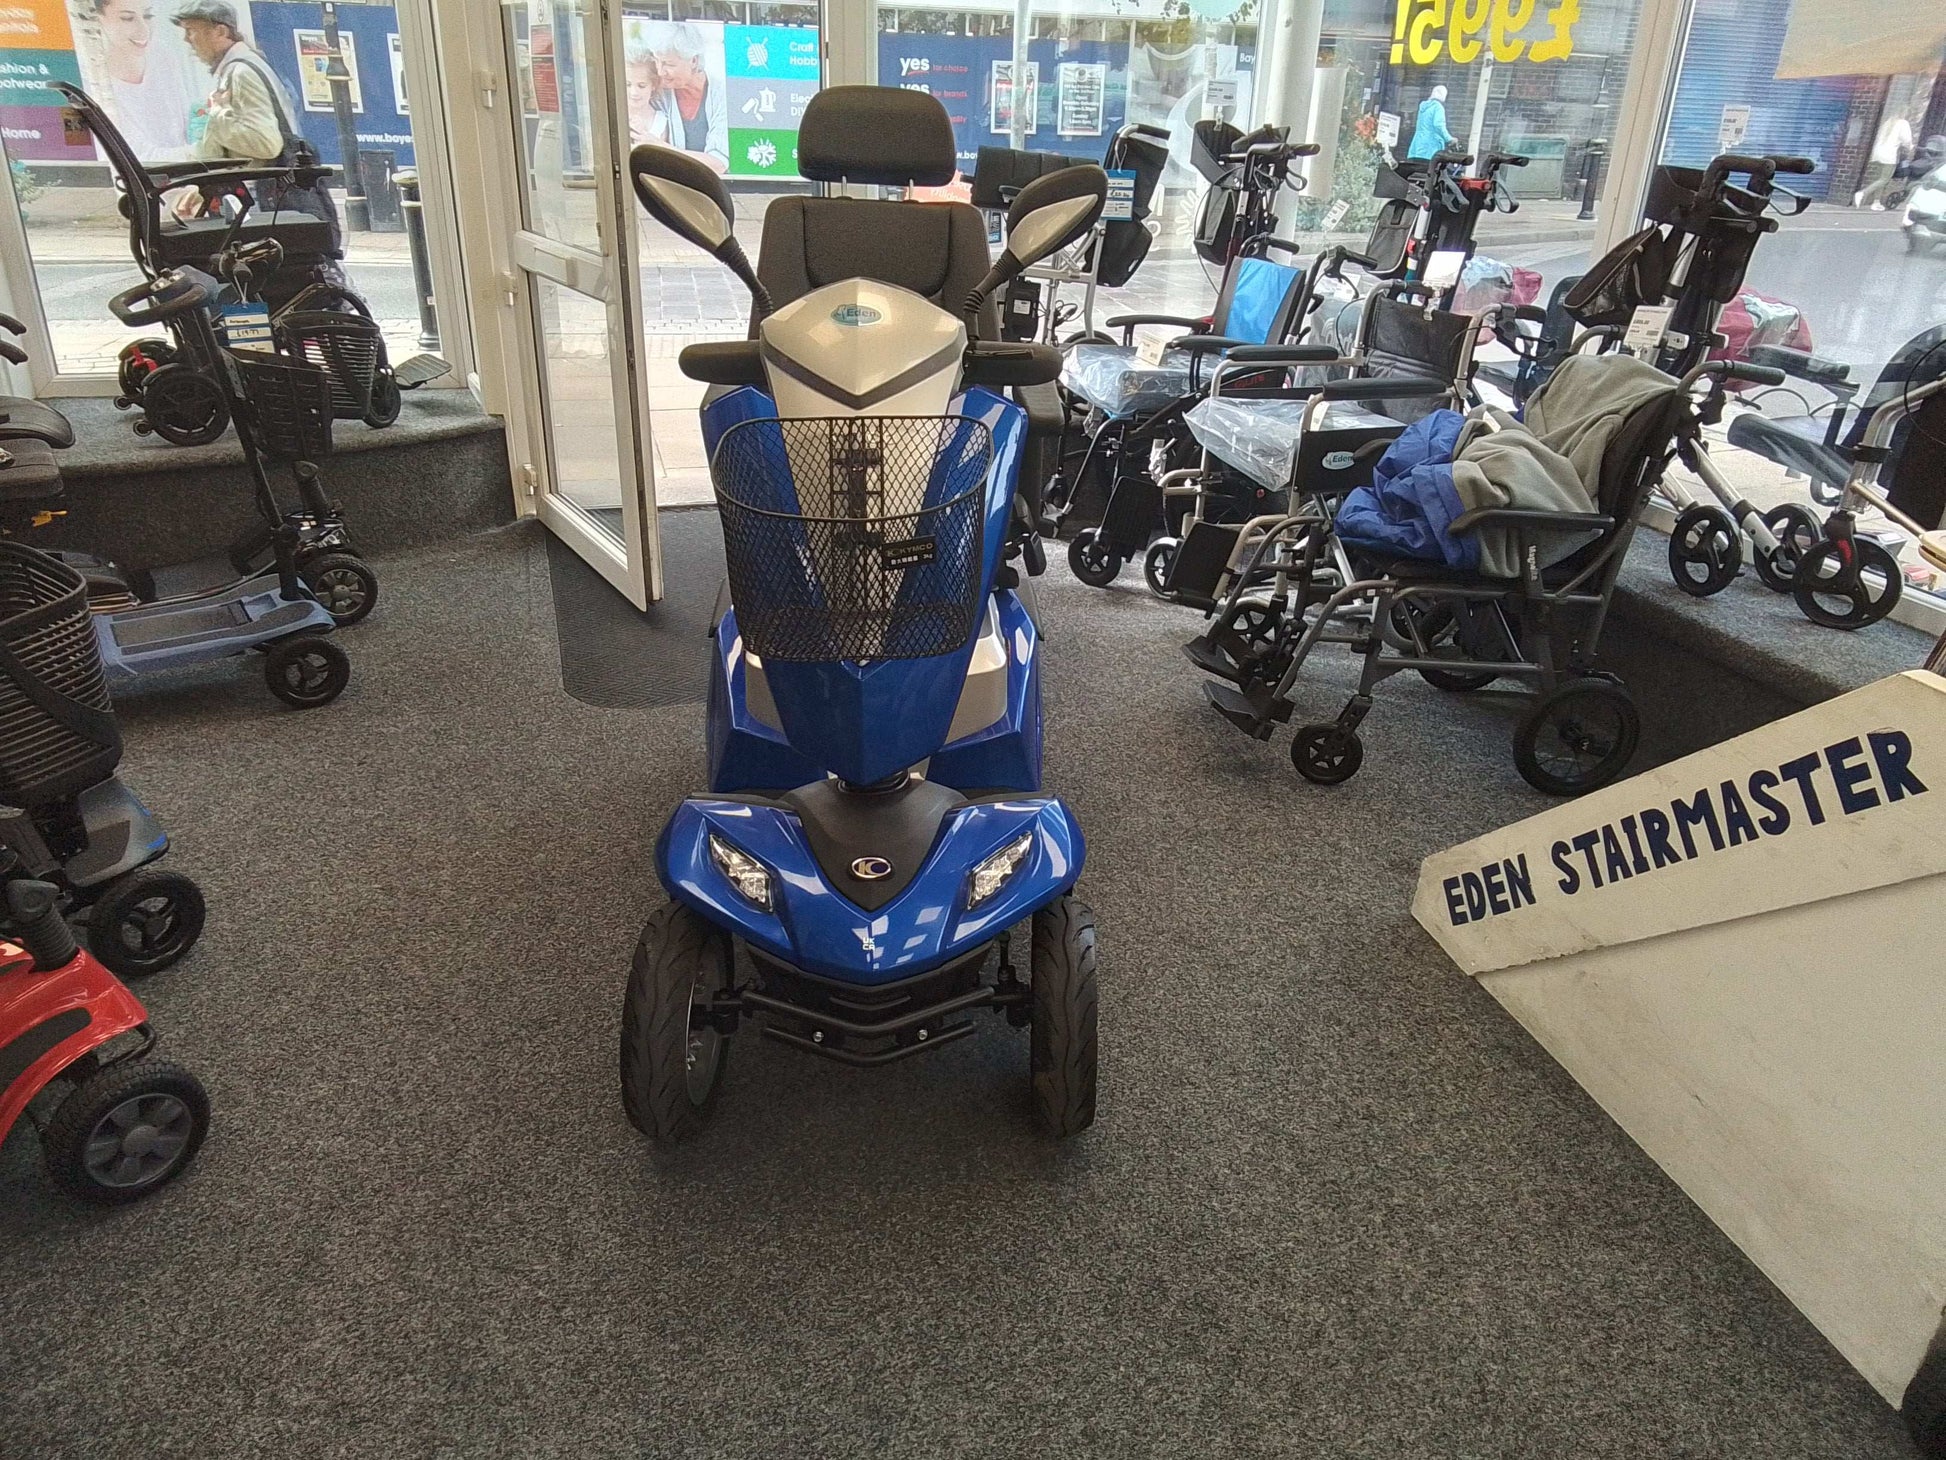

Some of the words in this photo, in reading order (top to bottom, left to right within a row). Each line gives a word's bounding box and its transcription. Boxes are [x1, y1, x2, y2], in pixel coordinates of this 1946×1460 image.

[789, 41, 814, 52] Craft
[789, 56, 819, 66] Hobb
[900, 57, 930, 76] yes
[790, 93, 813, 104] Elec
[847, 309, 876, 318] Eden
[1333, 455, 1354, 463] Eden
[900, 543, 934, 554] KYMCO
[1443, 854, 1536, 926] EDEN
[1551, 729, 1929, 896] STAIRMASTER
